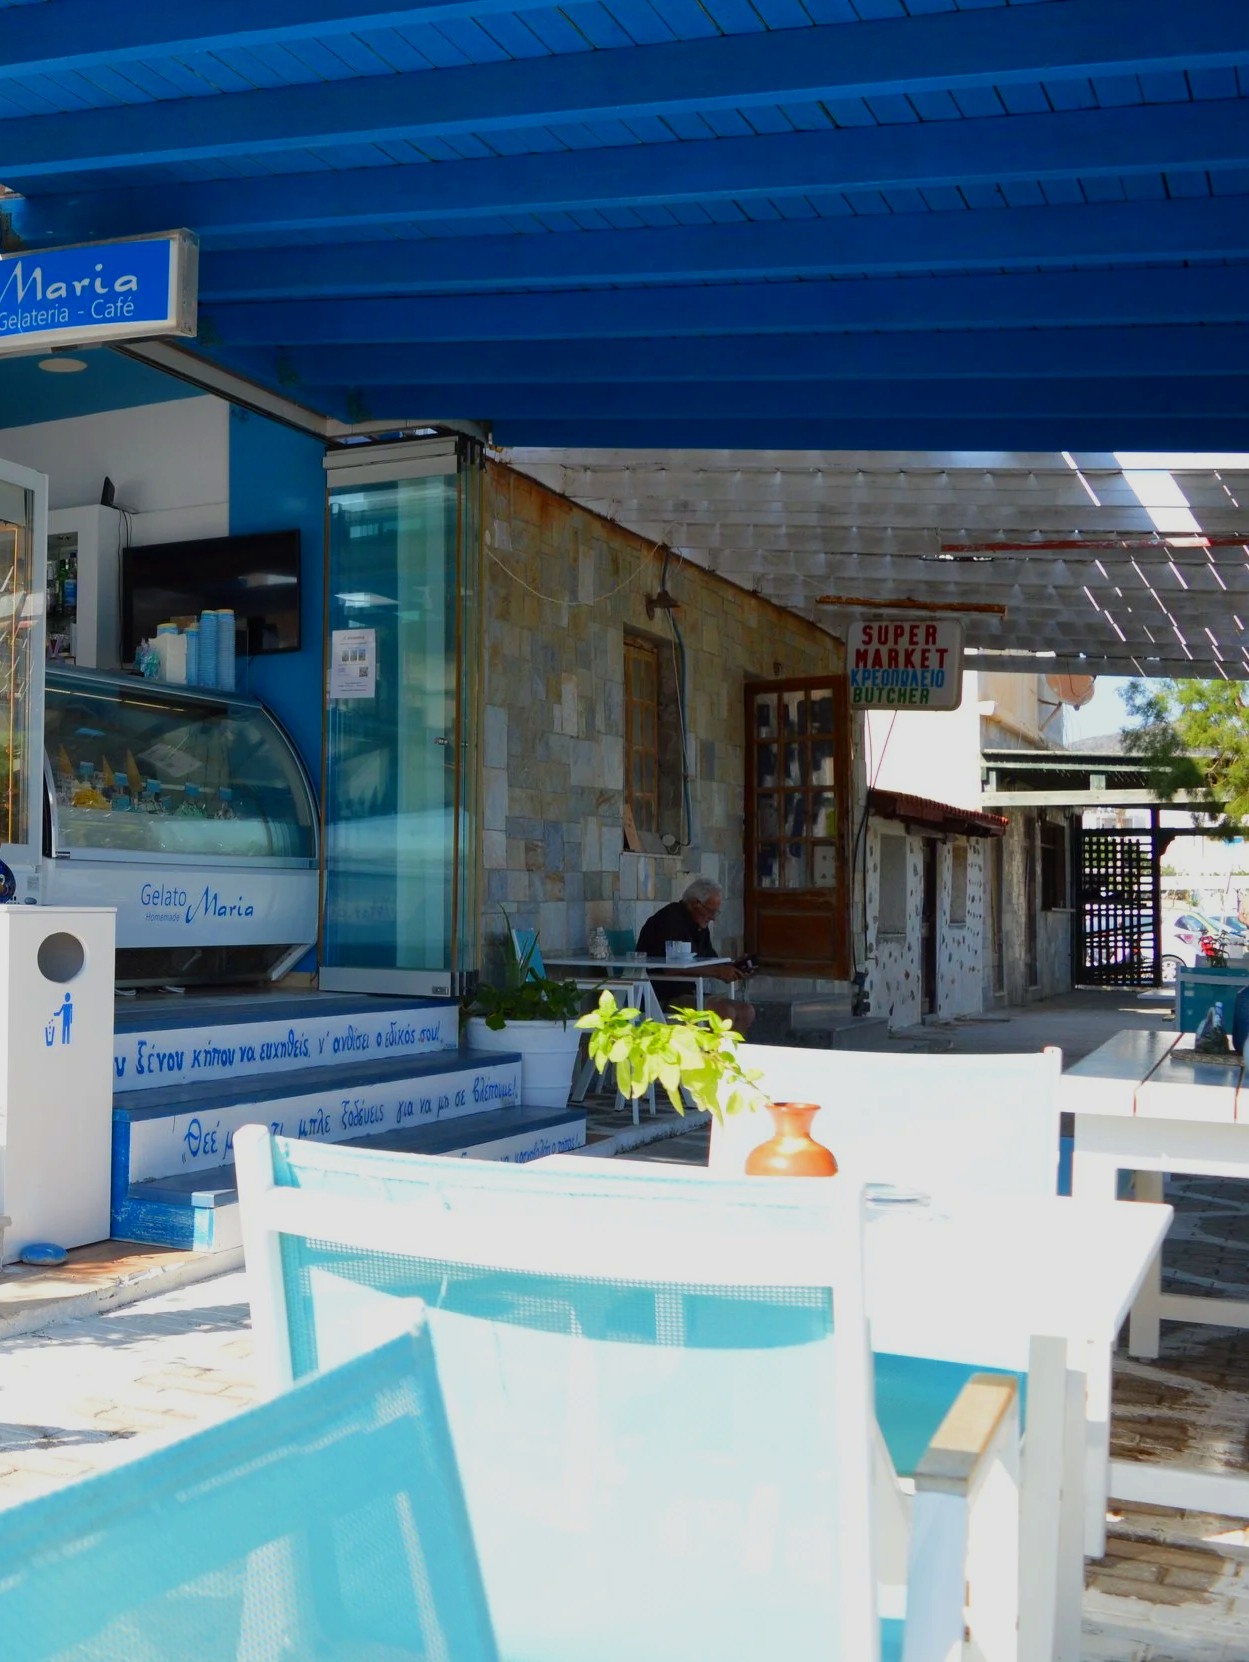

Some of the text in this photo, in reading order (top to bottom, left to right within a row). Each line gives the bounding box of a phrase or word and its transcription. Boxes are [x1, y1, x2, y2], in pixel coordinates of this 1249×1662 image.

[91, 296, 135, 319] Café
[862, 624, 938, 646] SUPER
[854, 648, 949, 669] MARKET
[852, 687, 930, 704] BUTCHER
[141, 884, 254, 924] Gelato Maria
[191, 1039, 236, 1068] κήπου
[239, 1046, 256, 1062] να
[298, 1108, 331, 1139] μπλε
[396, 1101, 413, 1124] για
[420, 1098, 432, 1114] να
[454, 1089, 466, 1107] σε
